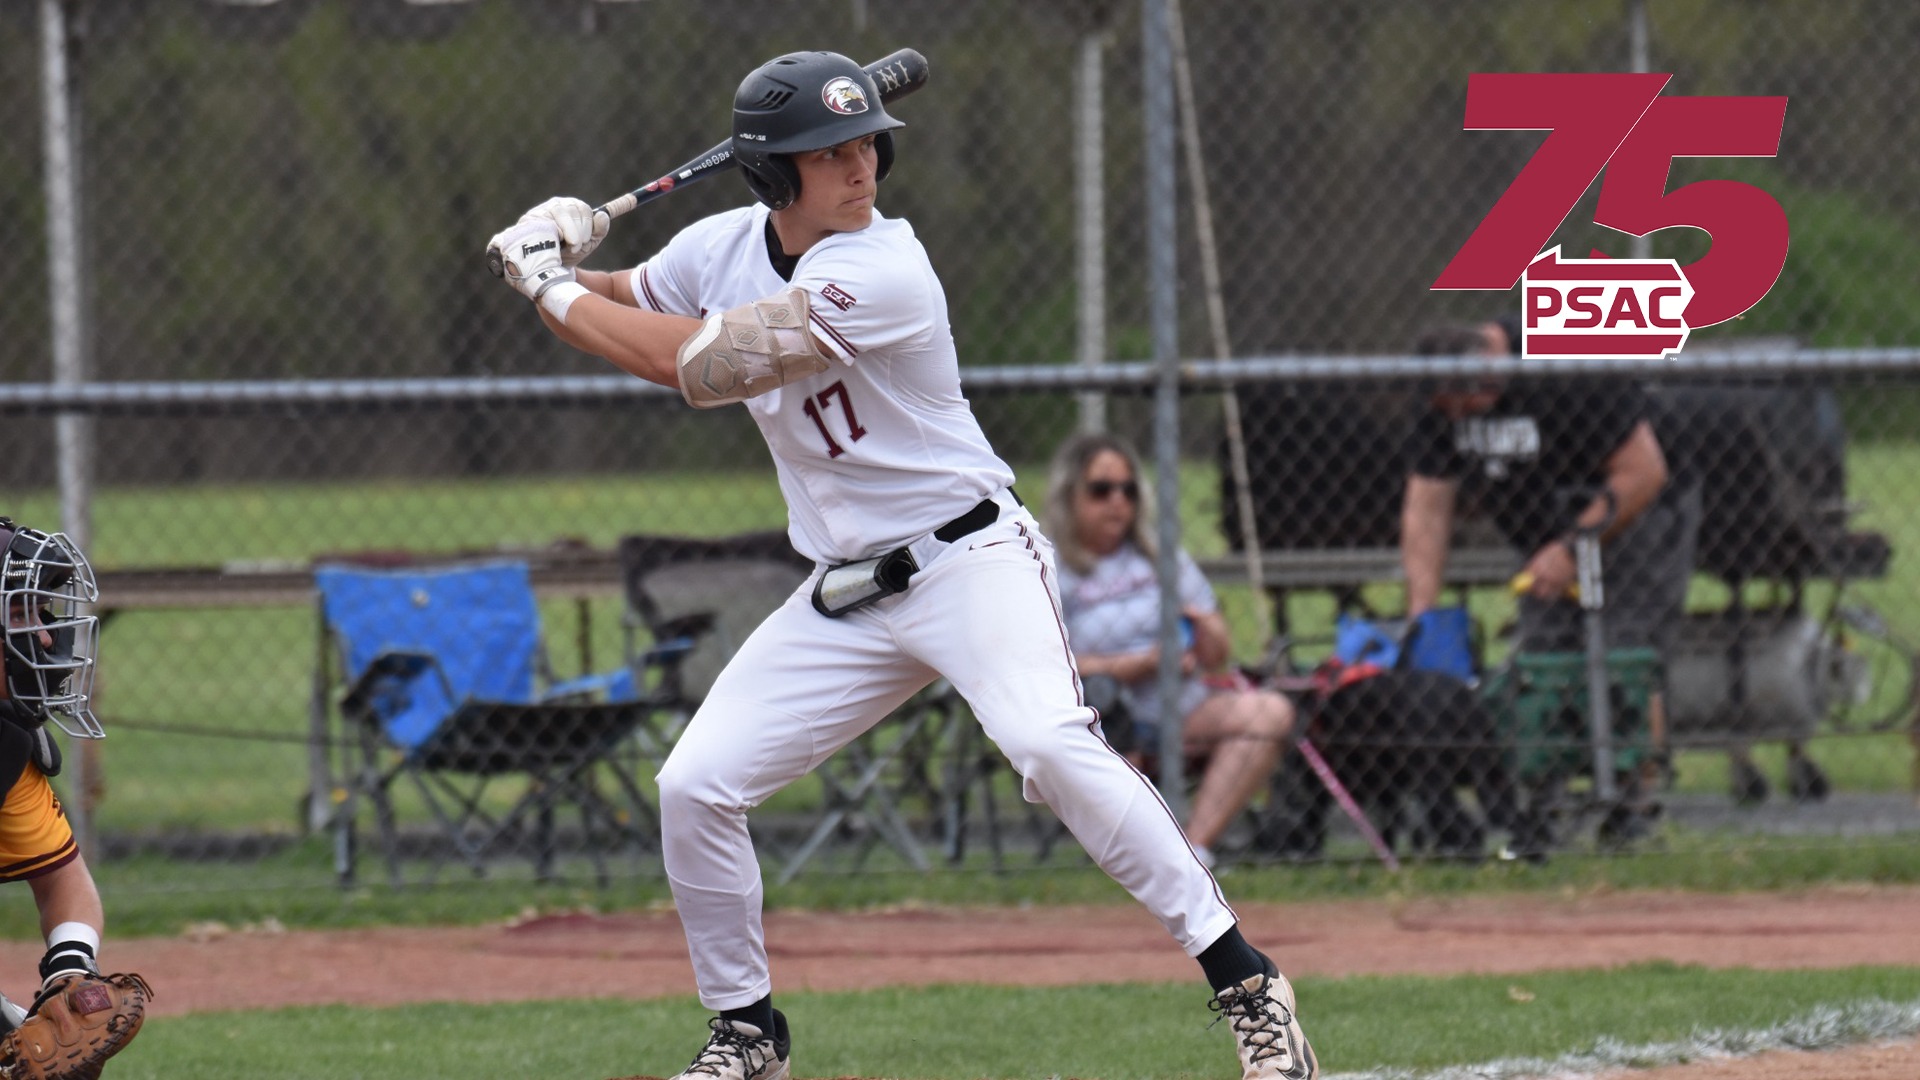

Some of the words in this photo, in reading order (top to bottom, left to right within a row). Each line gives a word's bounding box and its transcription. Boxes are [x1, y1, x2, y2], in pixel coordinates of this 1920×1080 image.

[522, 240, 556, 258] Franklin
[820, 286, 855, 309] PSAC
[803, 379, 867, 459] 17
